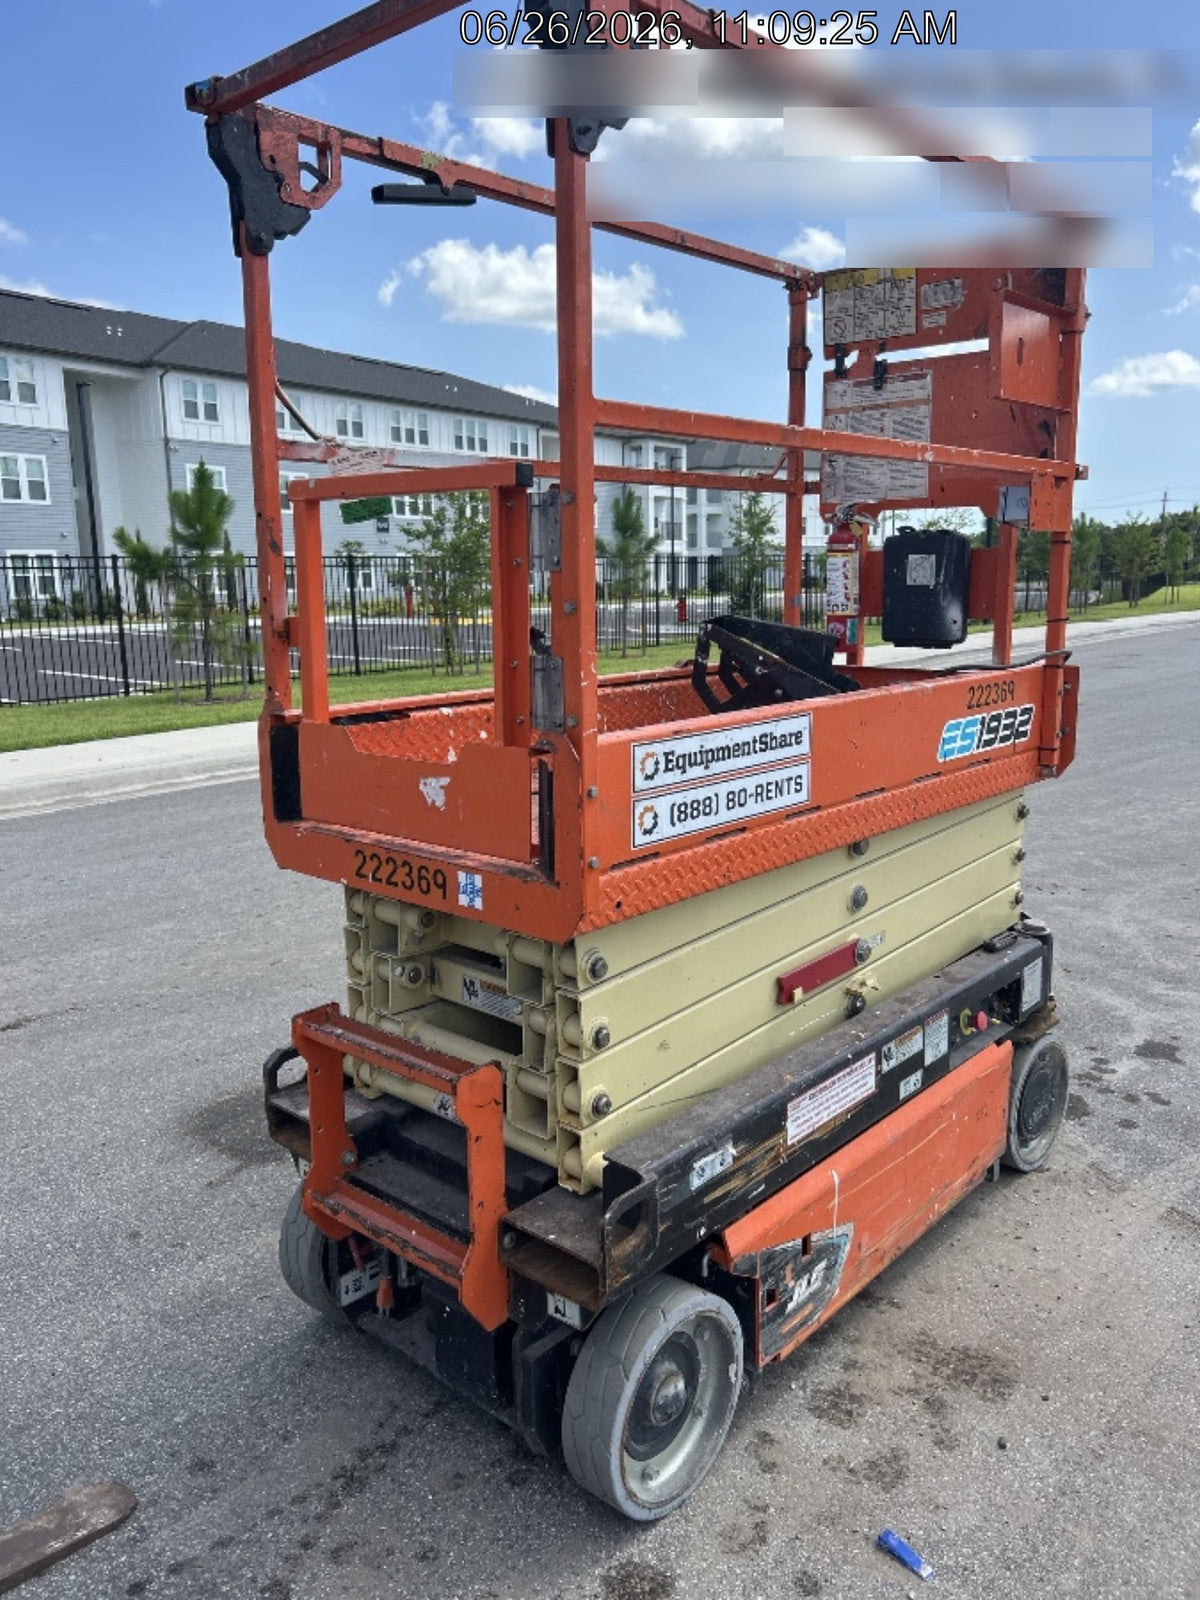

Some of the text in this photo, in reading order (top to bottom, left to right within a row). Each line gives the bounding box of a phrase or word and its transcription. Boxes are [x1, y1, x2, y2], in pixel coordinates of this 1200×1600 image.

[967, 681, 1015, 710] 222369
[663, 730, 803, 774] EquipmentShare
[938, 705, 1034, 761] ES1932
[669, 775, 803, 827] (888) 80-RENTS
[355, 849, 447, 901] 222369
